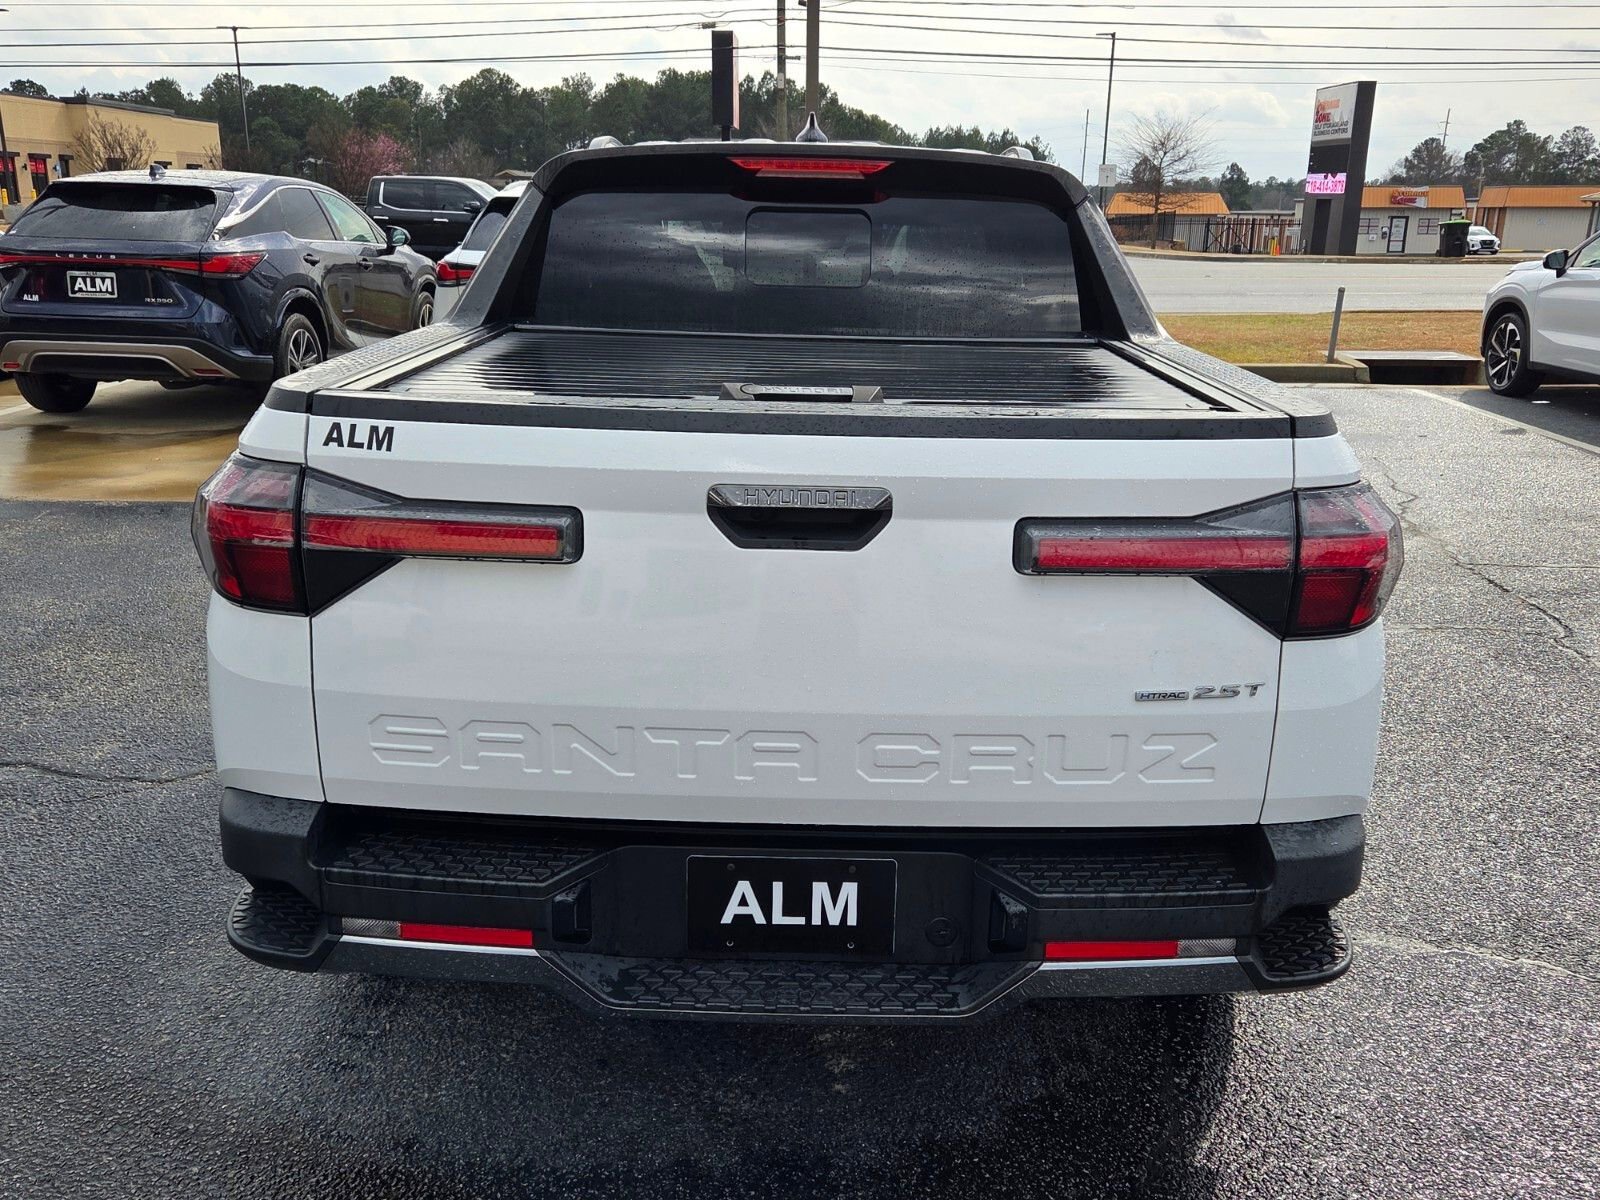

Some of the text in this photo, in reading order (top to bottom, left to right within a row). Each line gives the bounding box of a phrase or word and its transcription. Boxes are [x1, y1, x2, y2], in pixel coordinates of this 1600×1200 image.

[74, 277, 112, 292] ALM
[322, 421, 395, 453] ALM
[744, 488, 856, 507] HYUNDAI
[1140, 691, 1186, 700] HTRAC
[368, 713, 1219, 785] SANTA CRUZ
[720, 880, 859, 927] ALM
